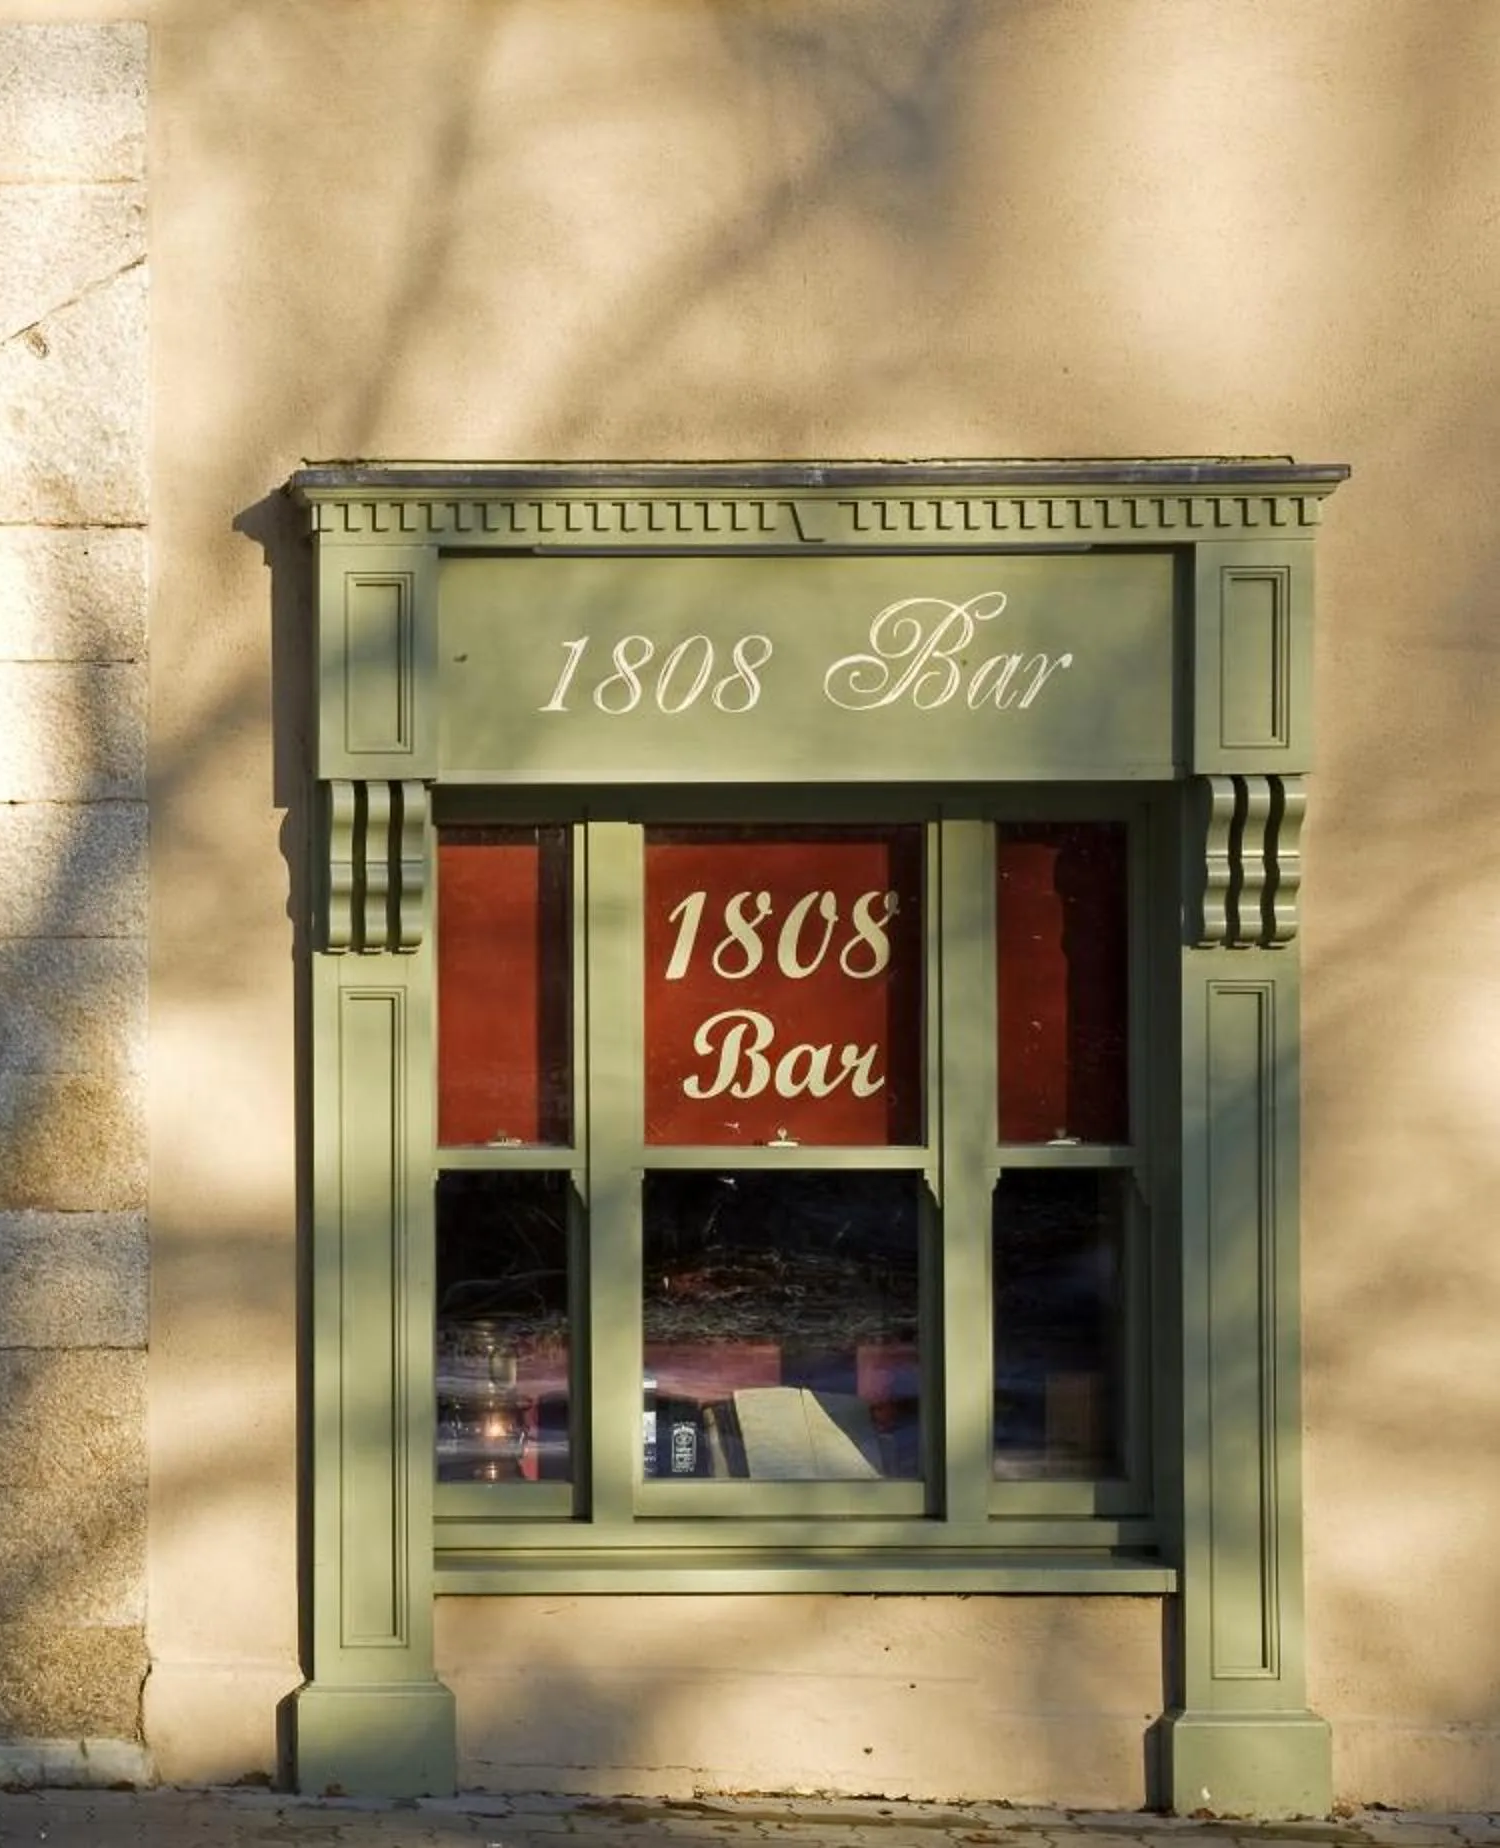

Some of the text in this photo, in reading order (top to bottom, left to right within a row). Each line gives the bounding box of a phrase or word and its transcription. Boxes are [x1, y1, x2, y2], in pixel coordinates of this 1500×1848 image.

[538, 591, 1073, 714] 1808 Bar
[665, 891, 900, 980] 1808
[682, 1008, 885, 1099] Bar
